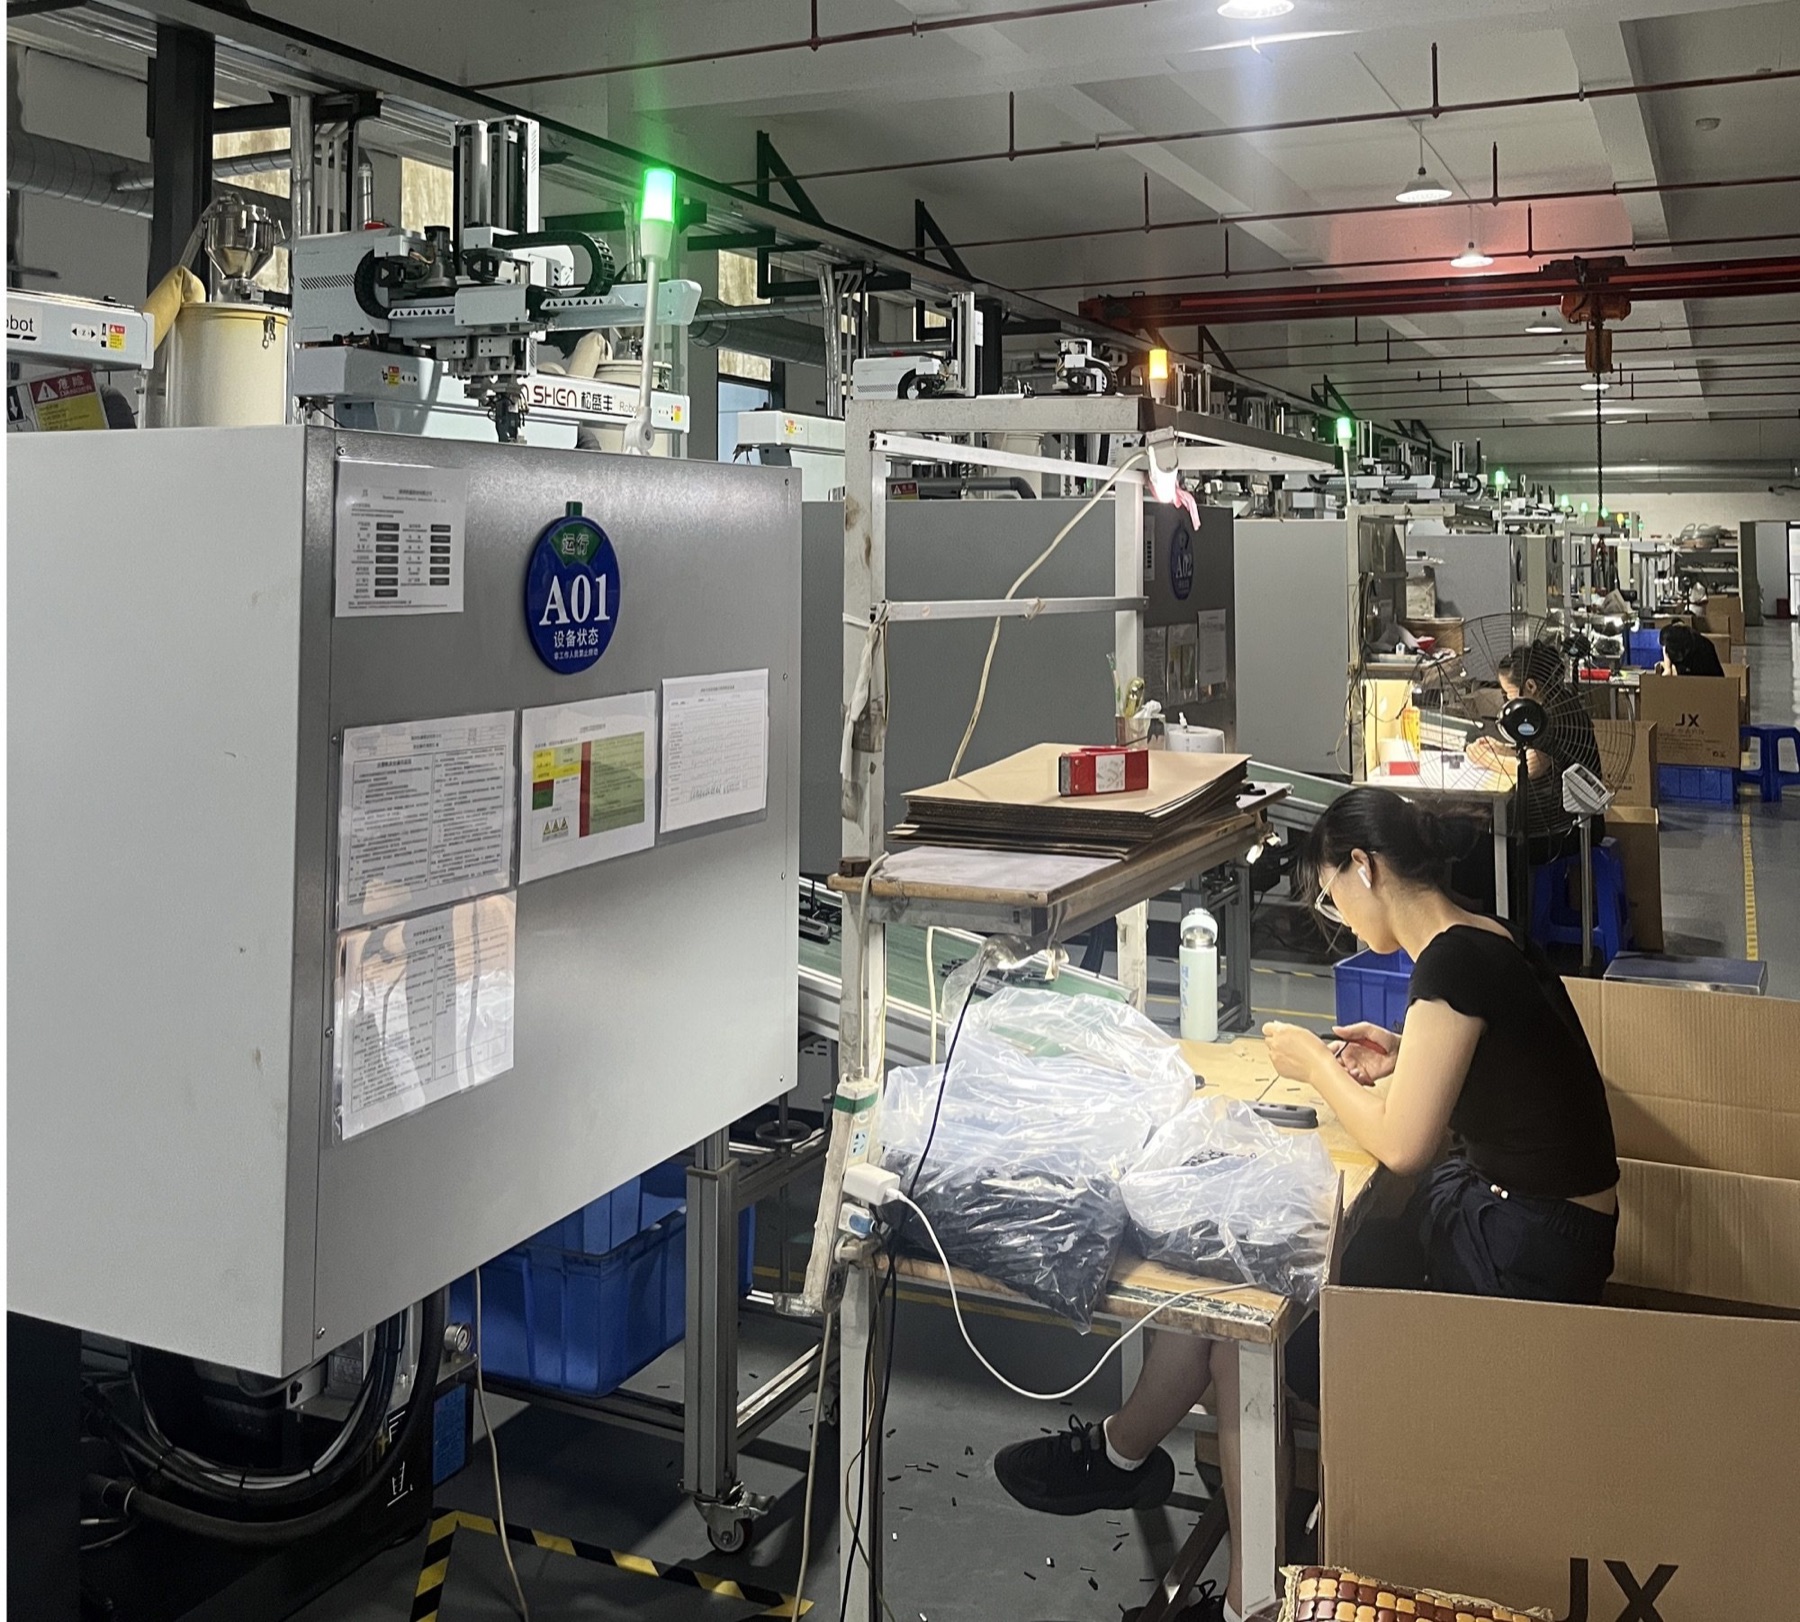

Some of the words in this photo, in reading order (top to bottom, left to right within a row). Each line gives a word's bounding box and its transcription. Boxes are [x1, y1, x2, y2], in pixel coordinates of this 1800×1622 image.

[580, 391, 613, 412] 松盛丰
[619, 401, 638, 414] Robo
[561, 532, 590, 556] 运行
[539, 573, 610, 626] A01
[553, 627, 599, 648] 设备状态
[1675, 713, 1700, 728] JX
[1553, 1557, 1679, 1622] JX
